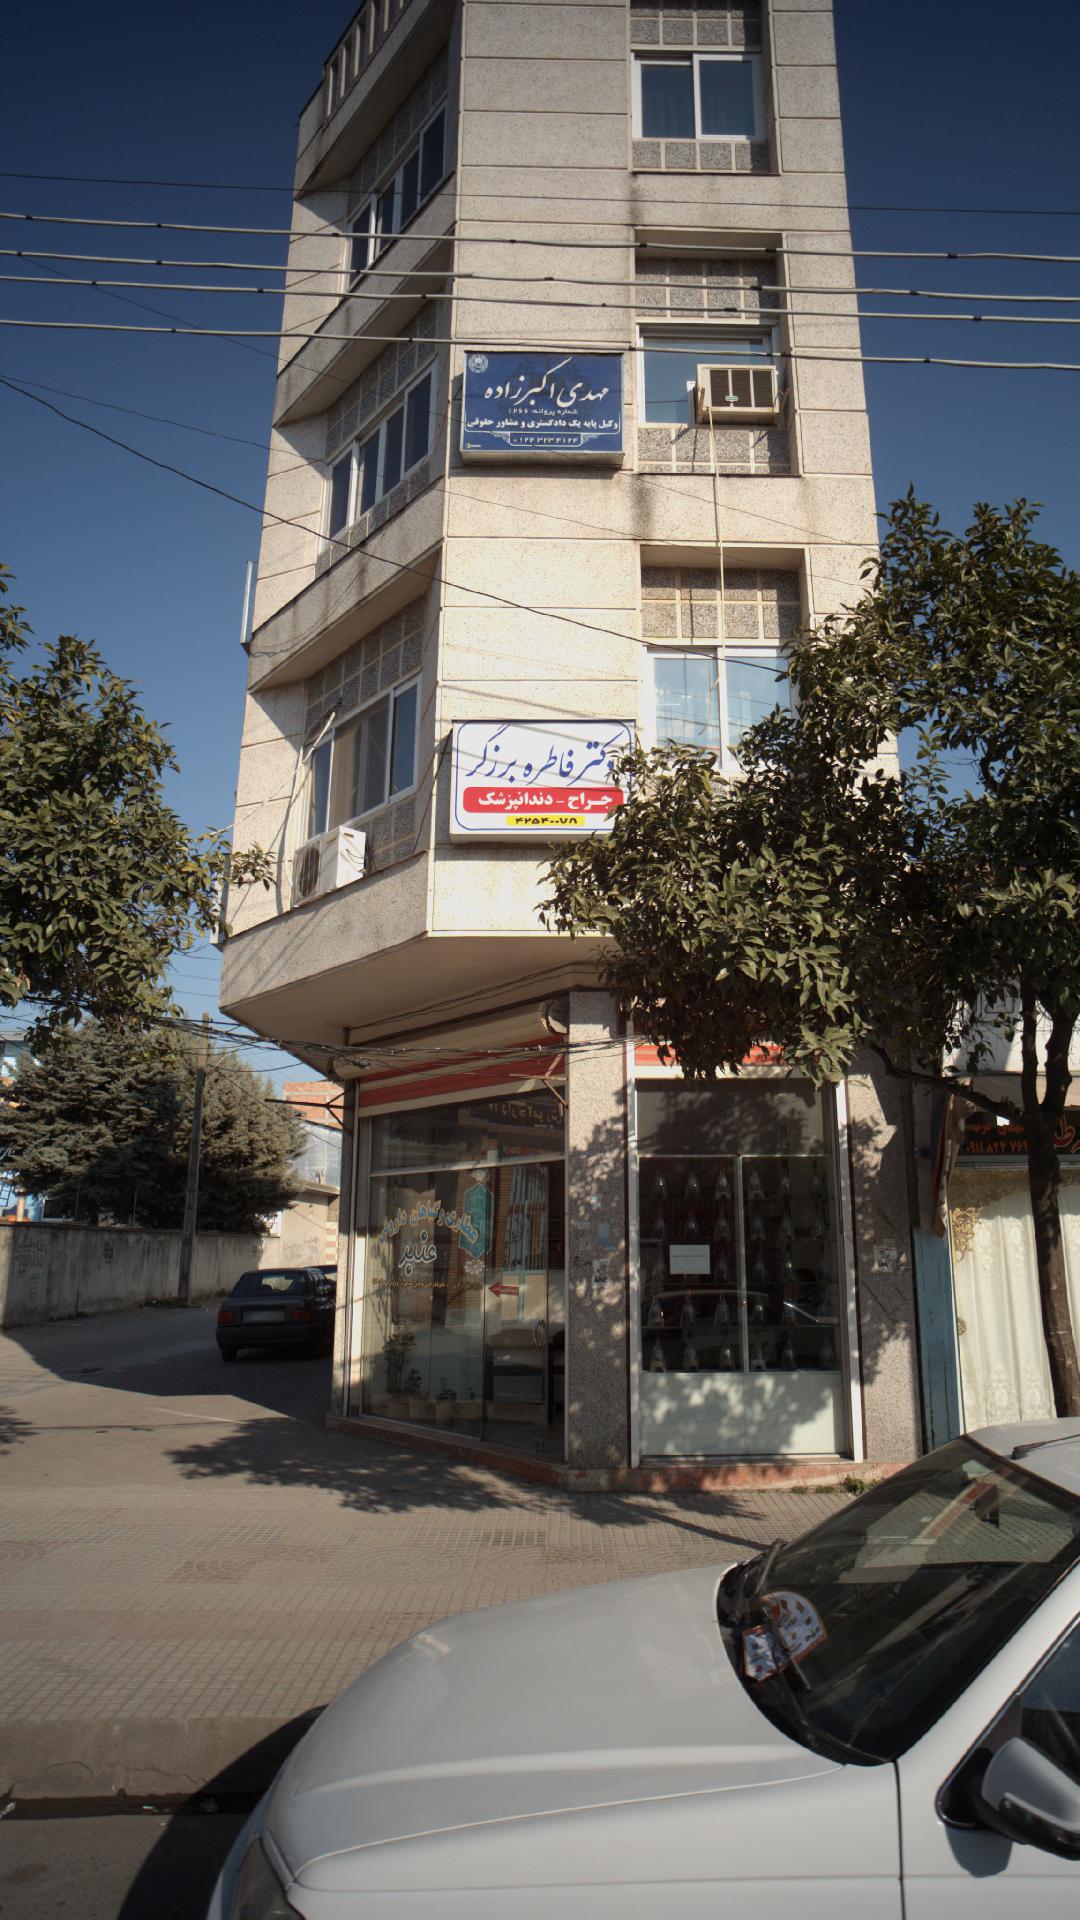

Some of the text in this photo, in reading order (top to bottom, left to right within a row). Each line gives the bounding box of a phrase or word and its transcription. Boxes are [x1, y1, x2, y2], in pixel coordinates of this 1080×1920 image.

[484, 357, 610, 408] مهدی اکبرزاده
[466, 416, 619, 430] وکیل پایه یک دادگستری و مشاور حقوقی
[557, 408, 578, 416] شماره
[465, 721, 518, 784] برزگر
[566, 729, 625, 787] کتر
[478, 792, 554, 811] دندانپزشک
[567, 794, 613, 810] جراح
[397, 1229, 437, 1277] عنبر
